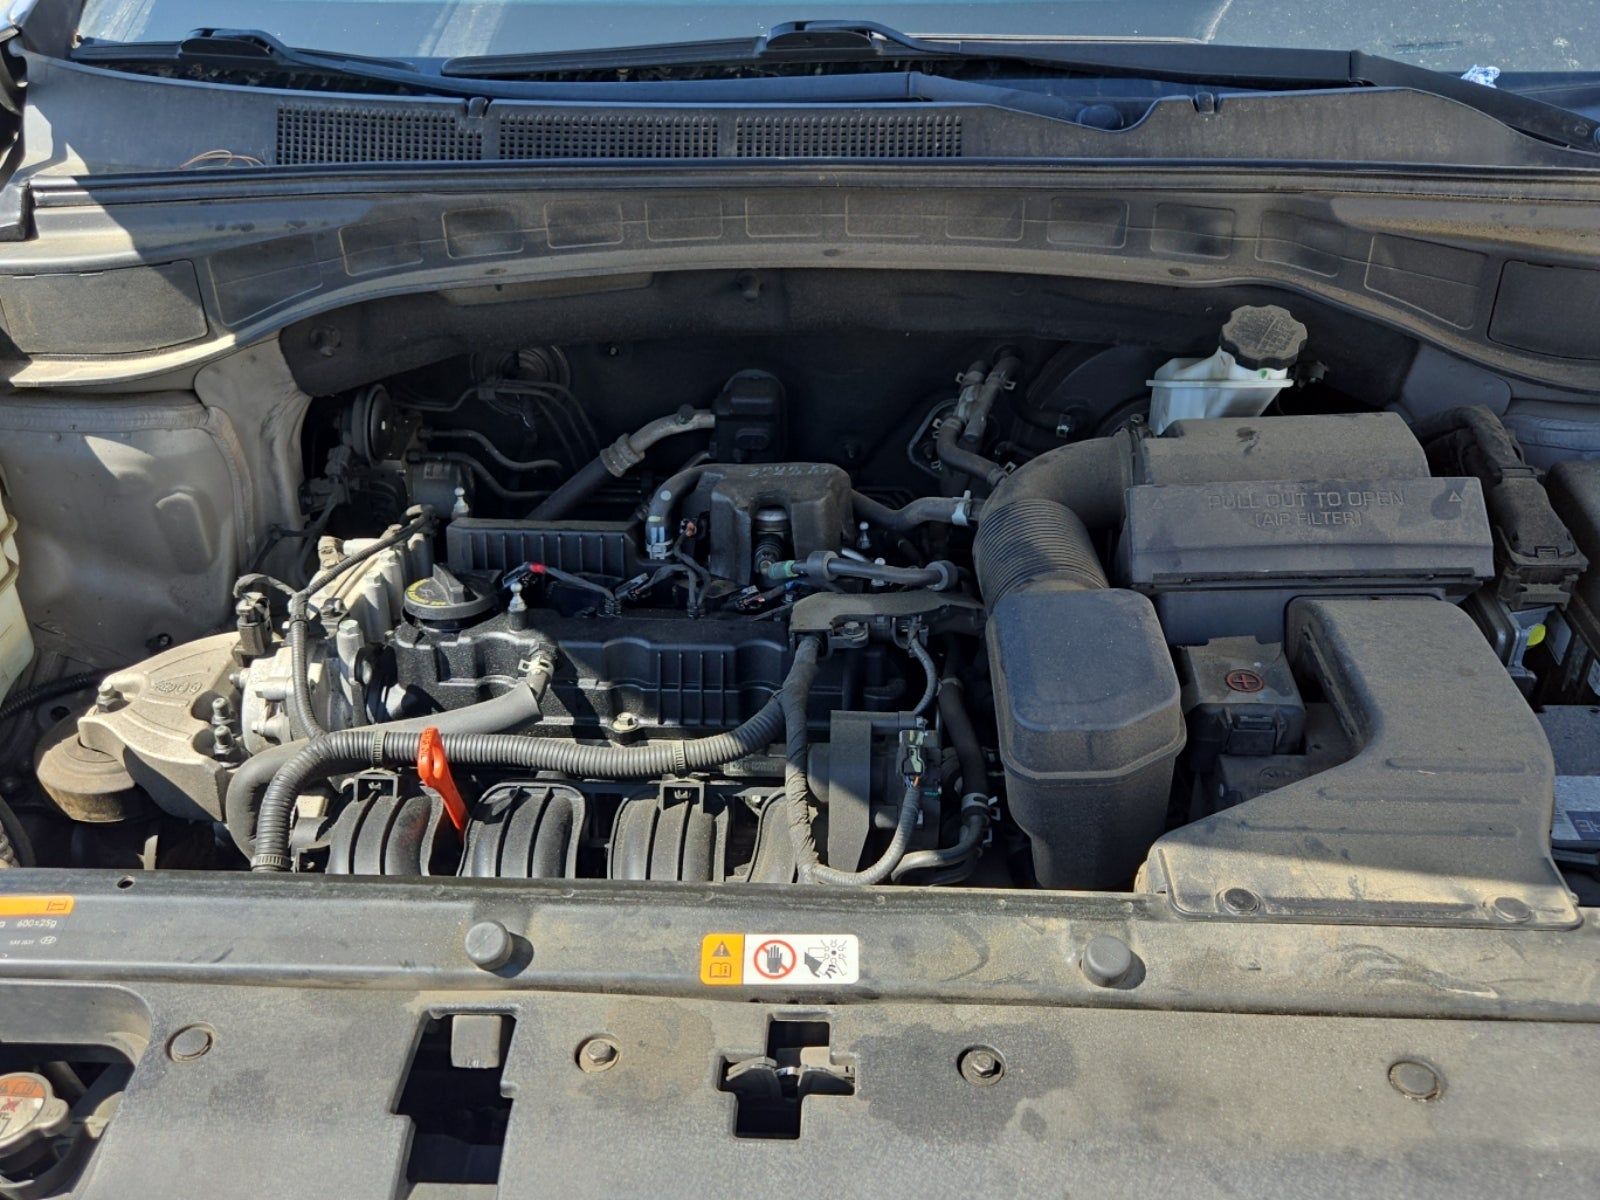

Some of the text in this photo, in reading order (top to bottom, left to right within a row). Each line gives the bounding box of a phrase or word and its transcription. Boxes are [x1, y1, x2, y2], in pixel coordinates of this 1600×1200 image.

[1208, 490, 1405, 510] PULL OUT TO OPEN
